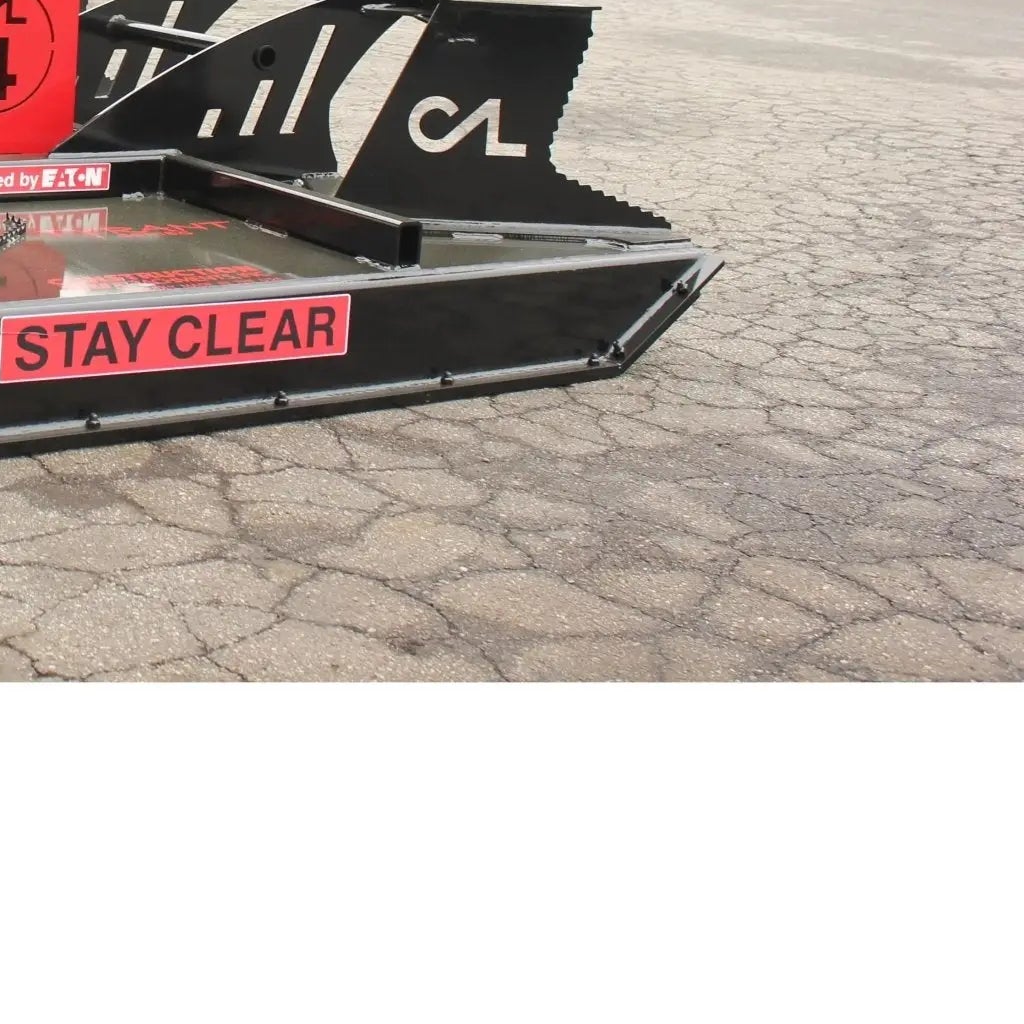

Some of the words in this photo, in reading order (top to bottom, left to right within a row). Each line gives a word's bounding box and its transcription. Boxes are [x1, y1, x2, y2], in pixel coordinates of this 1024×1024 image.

[19, 172, 40, 190] by
[15, 318, 151, 372] STAY
[168, 305, 337, 360] CLEAR
